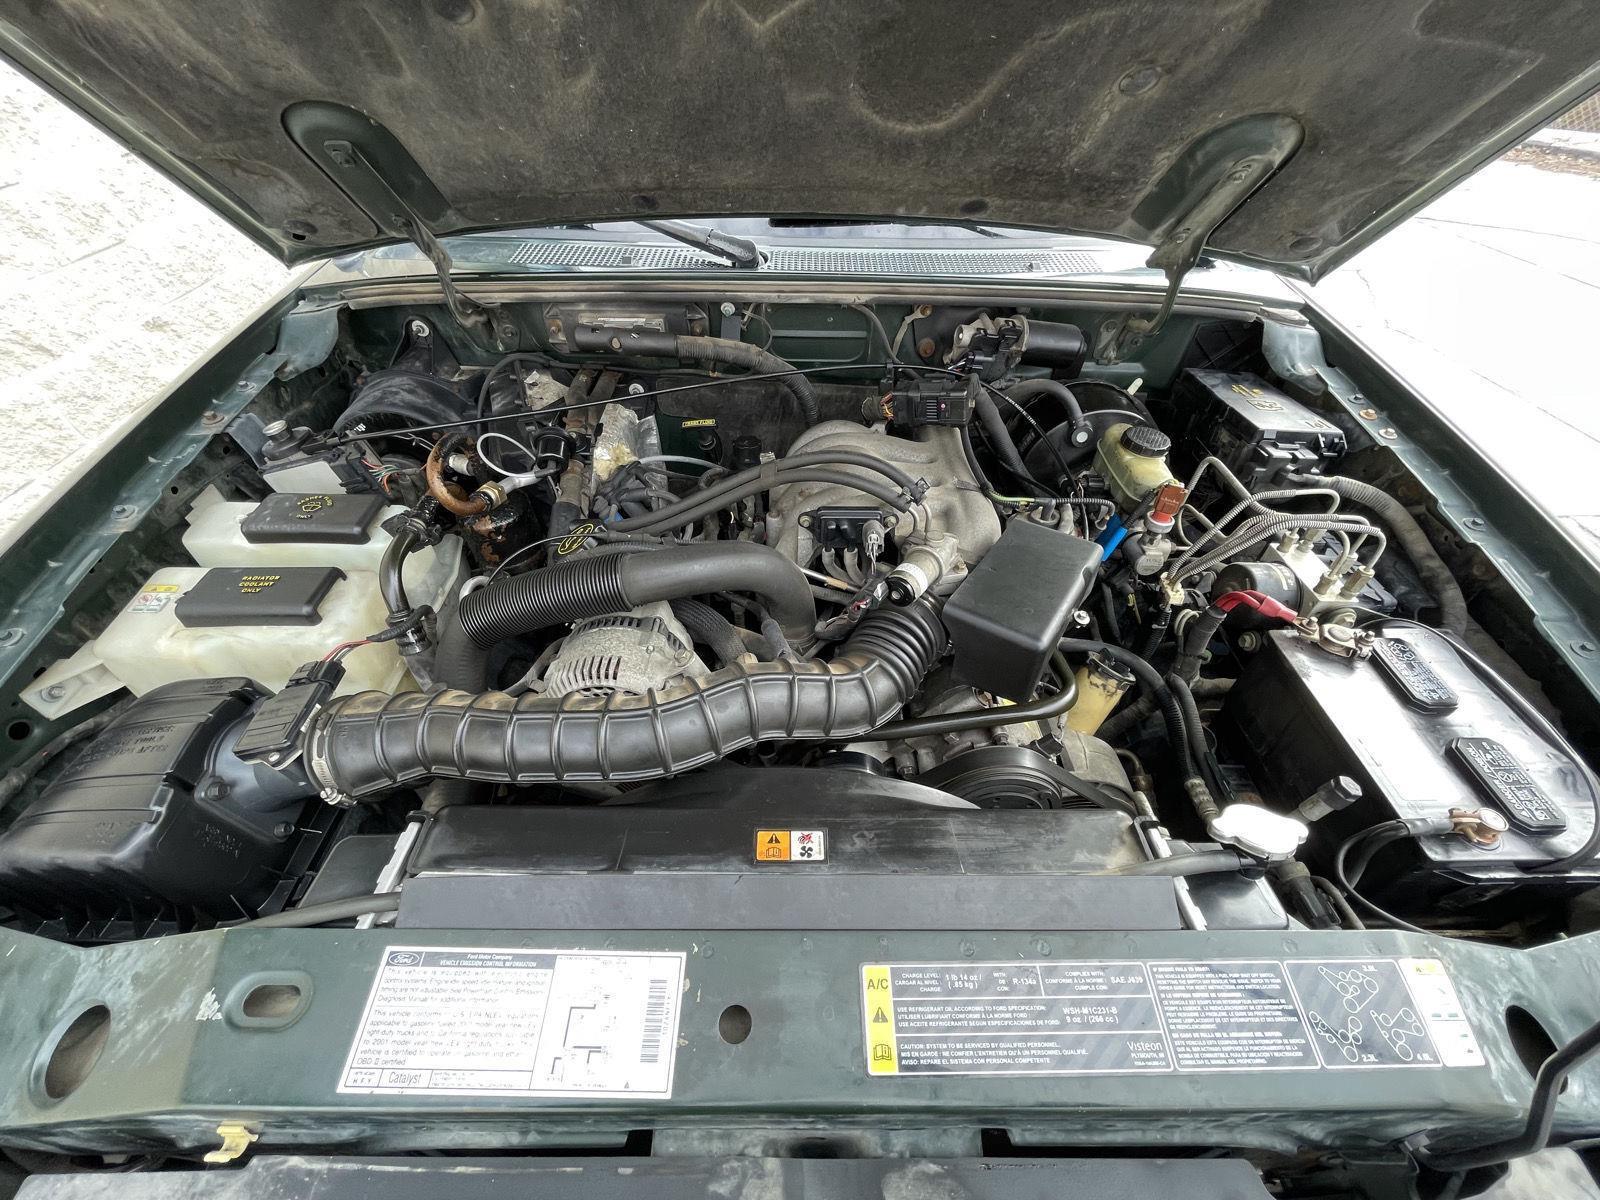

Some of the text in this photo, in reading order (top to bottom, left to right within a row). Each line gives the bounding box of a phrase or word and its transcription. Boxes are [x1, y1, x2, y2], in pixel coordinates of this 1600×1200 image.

[867, 978, 888, 990] A/C
[1062, 1006, 1118, 1014] WSH-M1C231-B
[1126, 1041, 1162, 1051] Visteon
[388, 1071, 422, 1086] Catalyst
